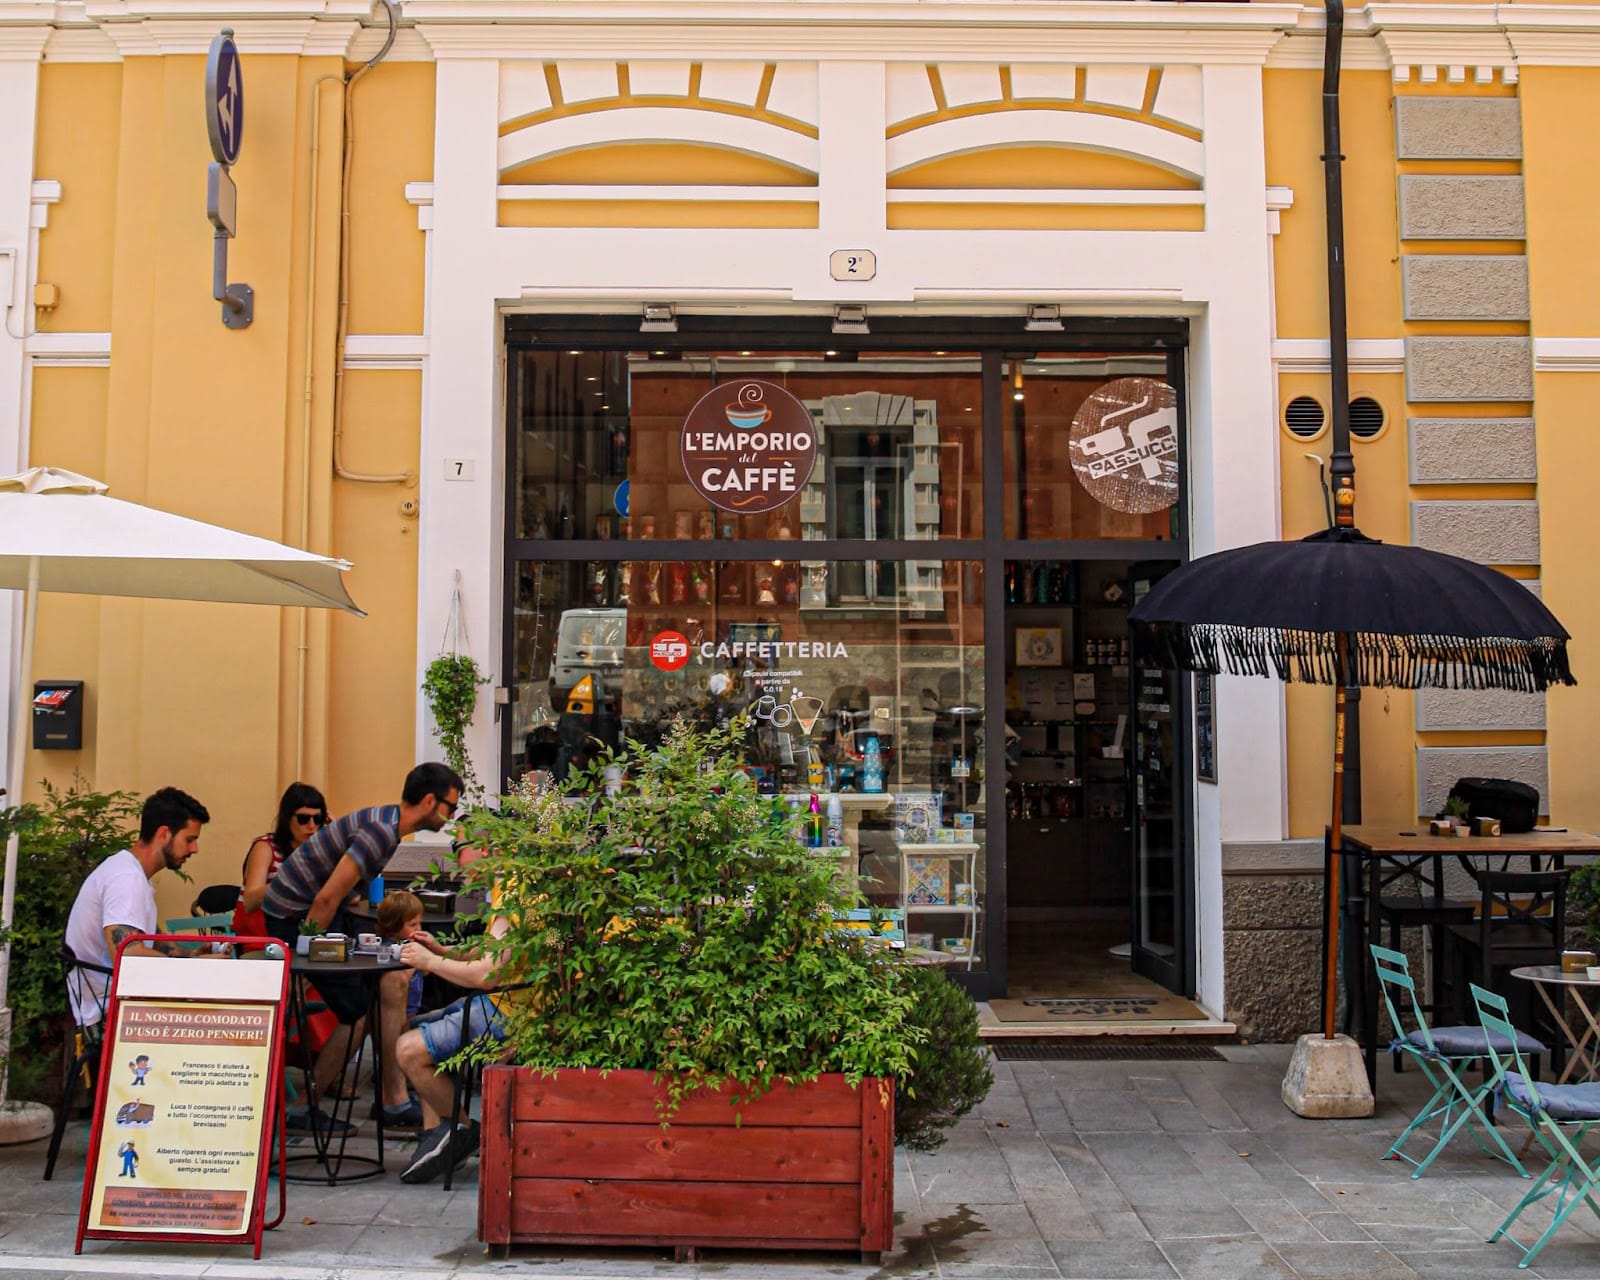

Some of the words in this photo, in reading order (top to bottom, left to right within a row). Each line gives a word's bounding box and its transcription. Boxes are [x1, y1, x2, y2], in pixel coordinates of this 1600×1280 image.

[685, 432, 811, 451] L'EMPORIO
[738, 452, 758, 463] del
[455, 462, 463, 476] 7
[701, 461, 796, 491] CAFFÈ
[700, 642, 848, 658] CAFFETTERIA
[130, 1012, 141, 1021] IL
[145, 1012, 191, 1023] NOSTRO
[194, 1013, 262, 1025] COMODATO
[125, 1026, 160, 1037] D'USO
[162, 1026, 170, 1038] È
[172, 1028, 204, 1038] ZERO
[206, 1029, 264, 1040] PENSIERI!
